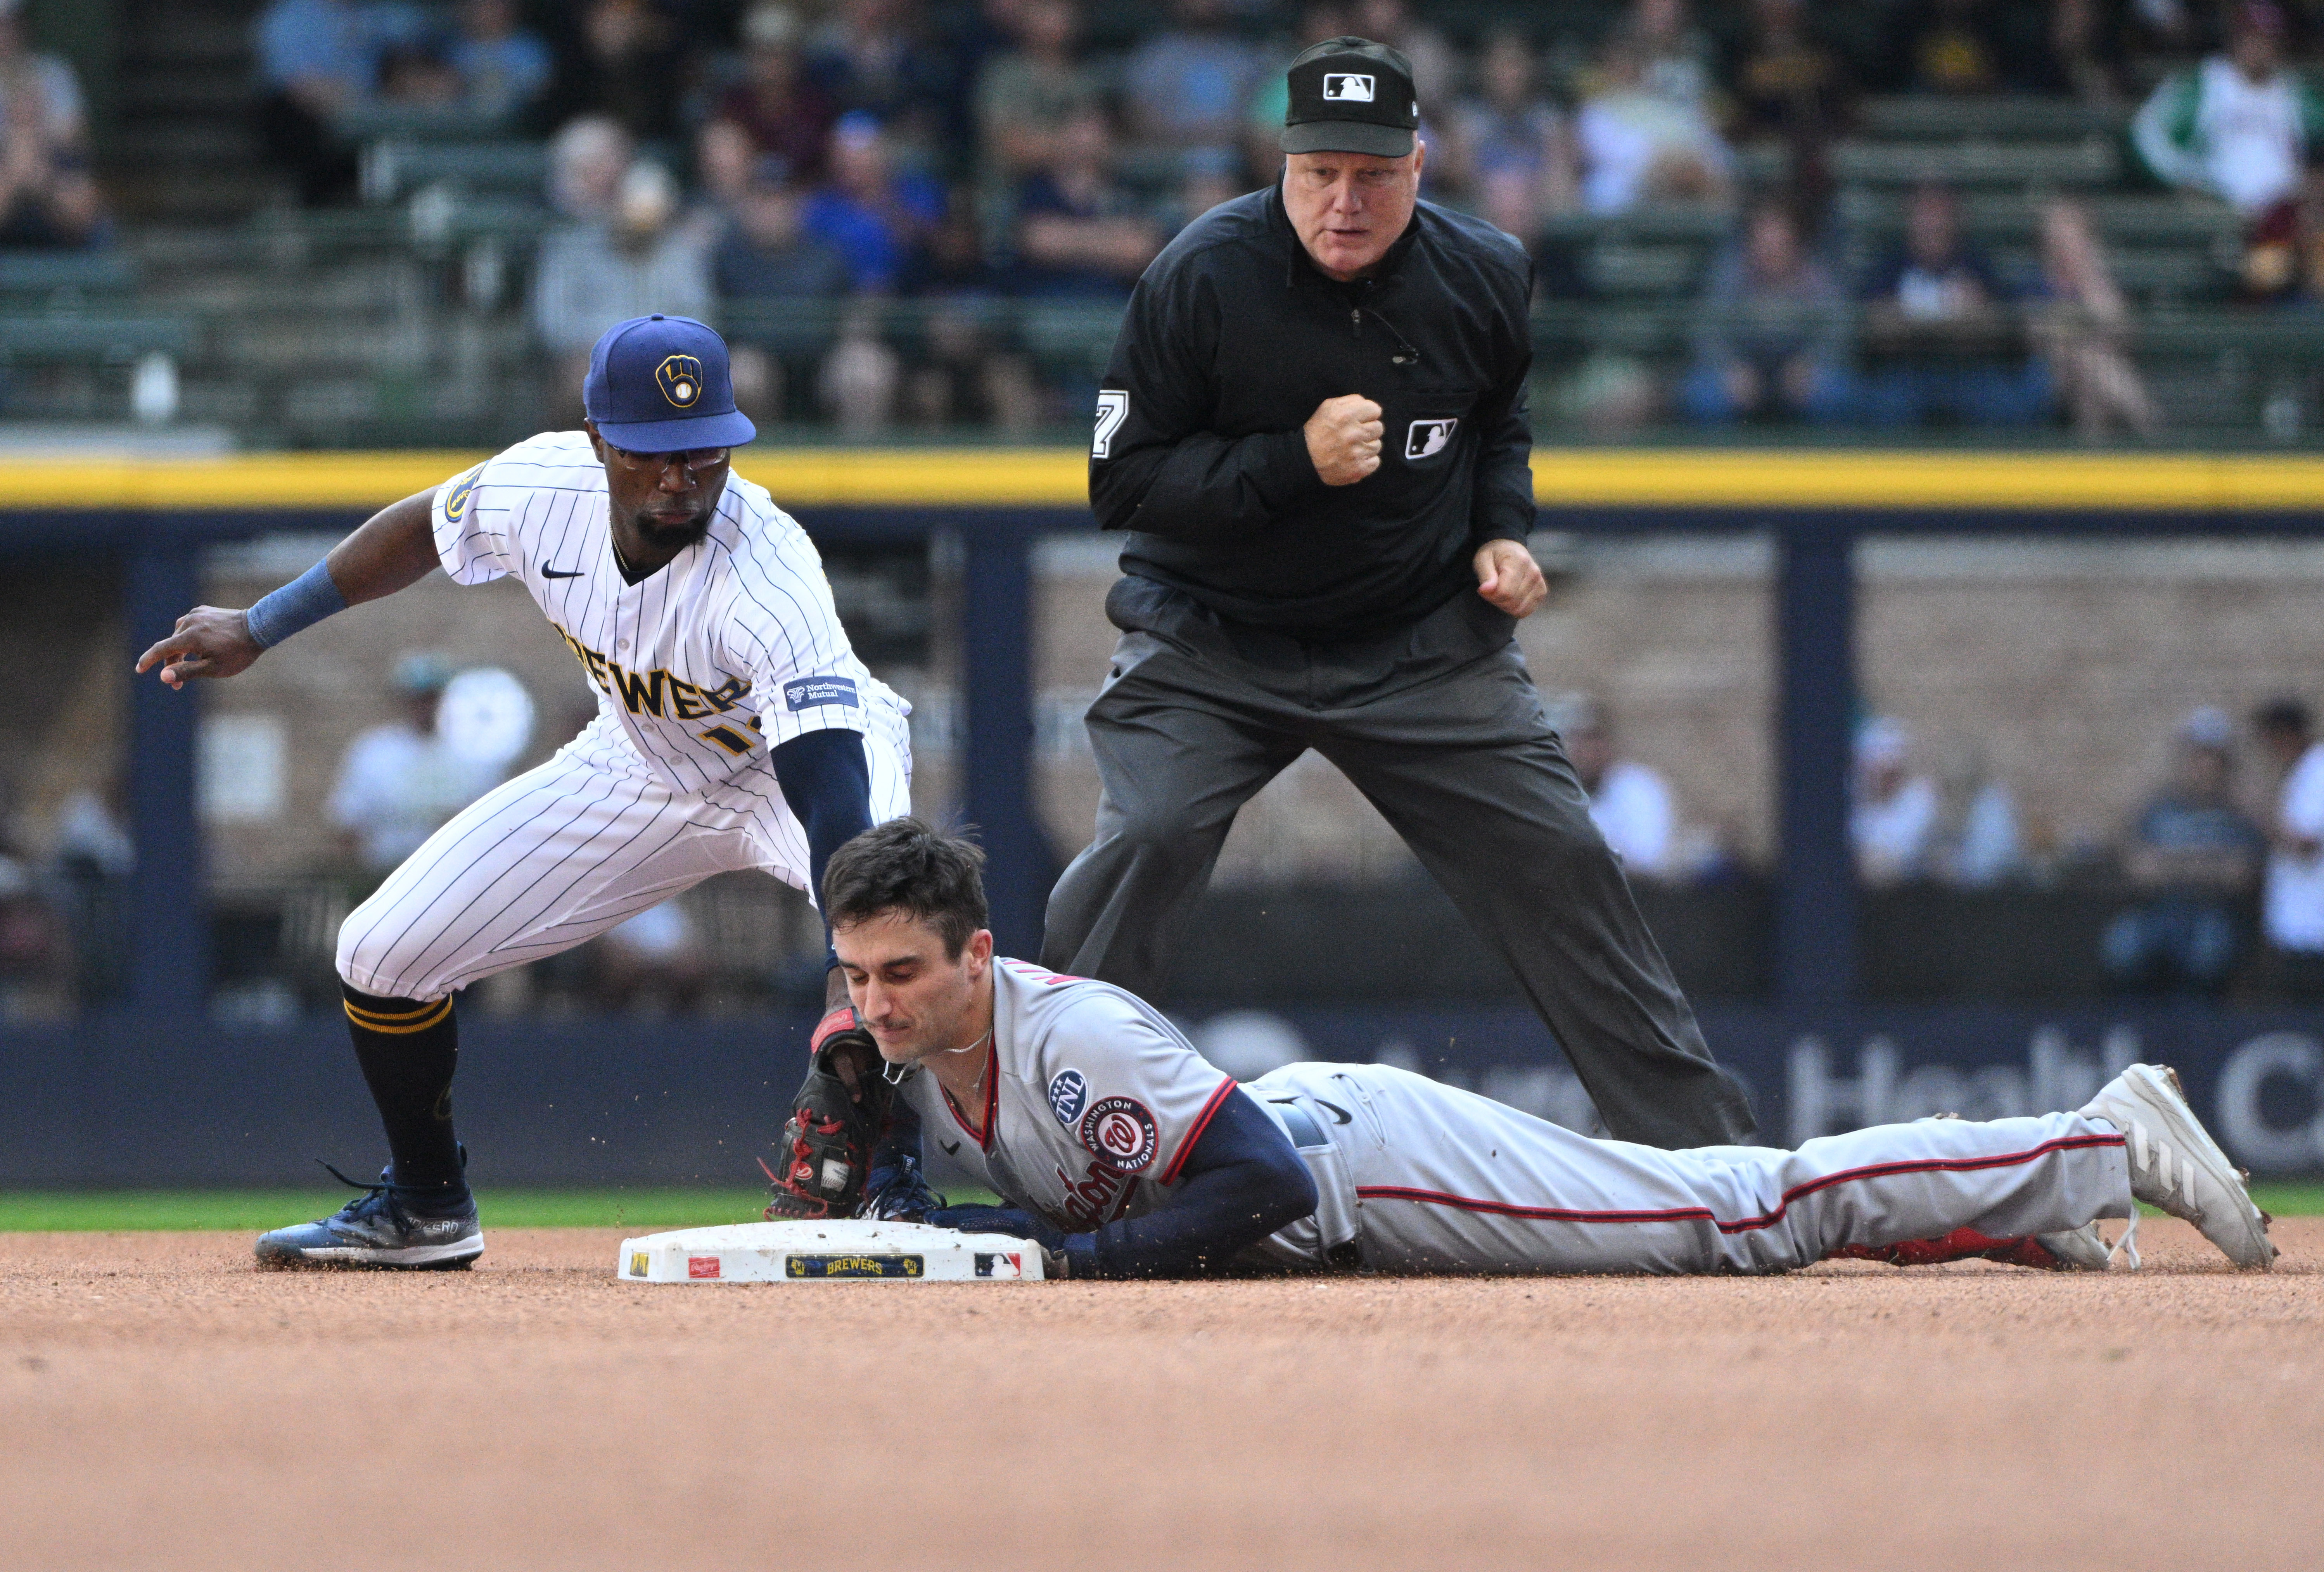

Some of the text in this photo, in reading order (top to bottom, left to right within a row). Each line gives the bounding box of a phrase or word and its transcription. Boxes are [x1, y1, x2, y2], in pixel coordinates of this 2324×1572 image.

[1092, 390, 1129, 459] 7
[806, 682, 856, 693] Northwestern
[808, 689, 839, 699] Mutual
[1056, 1076, 1084, 1122] TNL
[1084, 1100, 1131, 1151] WASHINGTON
[1117, 1123, 1154, 1169] NATIONALS
[827, 1258, 882, 1275] BREWERS
